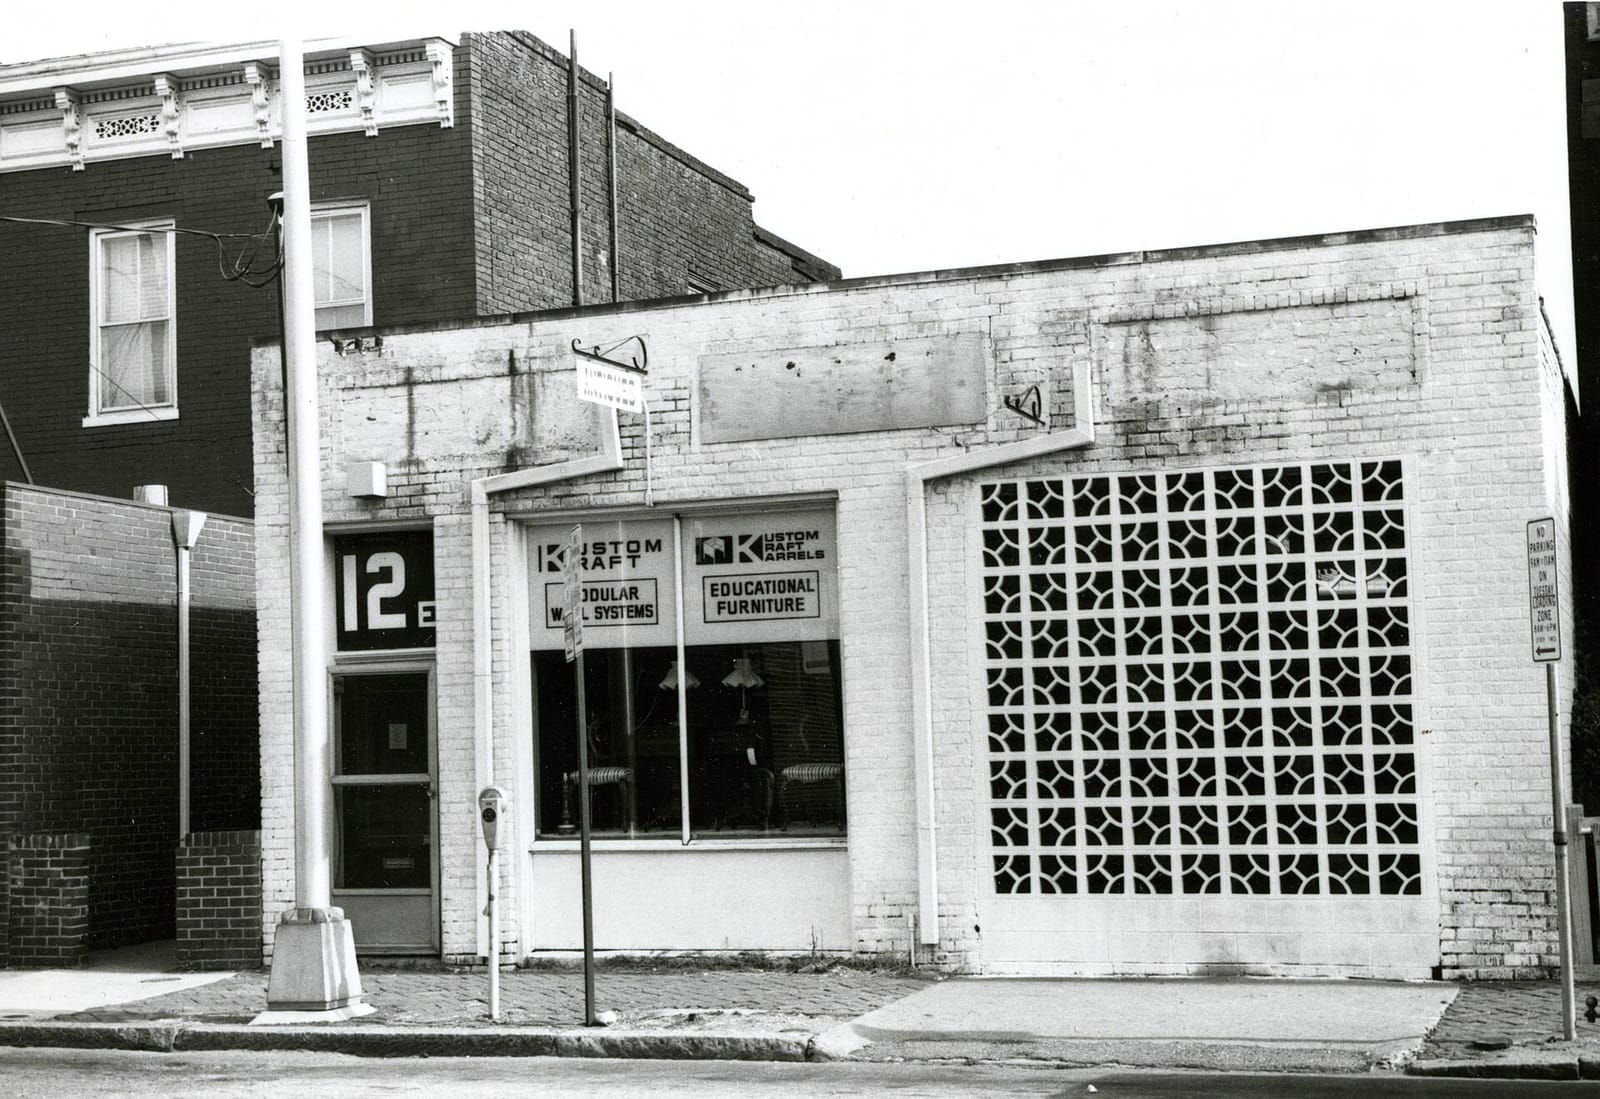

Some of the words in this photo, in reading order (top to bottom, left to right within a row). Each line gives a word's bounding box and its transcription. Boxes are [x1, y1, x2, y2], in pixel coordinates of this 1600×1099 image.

[1536, 526, 1545, 538] NO
[765, 542, 804, 552] RAFT
[1530, 540, 1554, 554] PARKING
[765, 550, 825, 561] ARRELS
[1538, 570, 1547, 582] ON
[343, 551, 407, 632] 12
[582, 586, 639, 602] ODULAR
[710, 578, 815, 597] EDUCATIONAL
[717, 597, 805, 615] FURNITURE
[1532, 595, 1556, 609] LOADING
[551, 607, 589, 621] WL
[594, 604, 654, 620] SYSTEMS
[1537, 609, 1552, 622] ZONE
